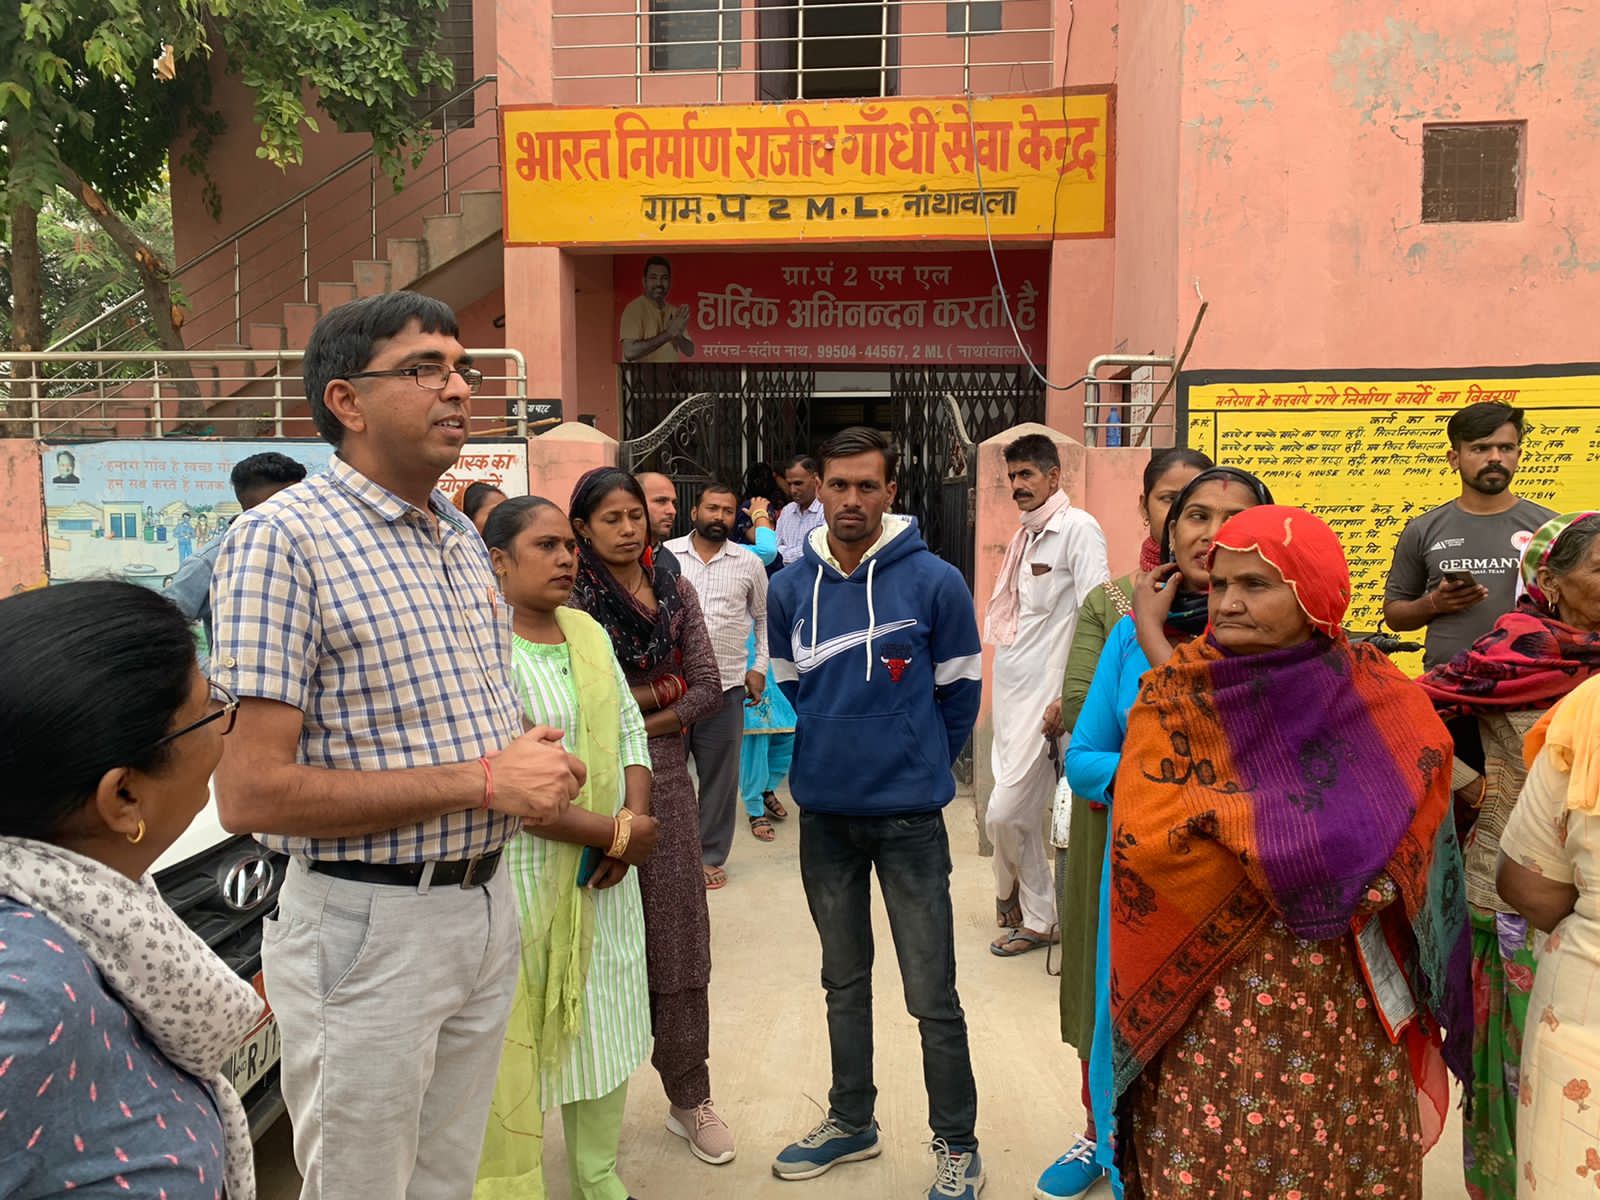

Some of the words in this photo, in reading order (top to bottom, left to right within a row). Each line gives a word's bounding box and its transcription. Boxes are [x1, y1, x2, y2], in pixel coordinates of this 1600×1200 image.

[516, 129, 611, 181] भारत
[614, 111, 732, 179] निर्माण
[735, 109, 839, 178] राजीव
[841, 105, 939, 176] गाँधी
[942, 103, 1013, 174] सेवा
[1018, 104, 1100, 180] केन्द्र
[768, 198, 791, 219] 2
[844, 266, 858, 286] 2
[869, 266, 904, 289] एम
[913, 266, 952, 290] एल
[787, 290, 926, 330] अभिनन्दन
[912, 344, 921, 358] 2
[925, 344, 943, 358] ML
[1342, 386, 1392, 405] निर्माण
[1436, 391, 1460, 404] का
[1406, 415, 1424, 424] का
[491, 454, 517, 470] का
[1308, 468, 1340, 477] HOUSE
[1440, 557, 1521, 569] GERMANY
